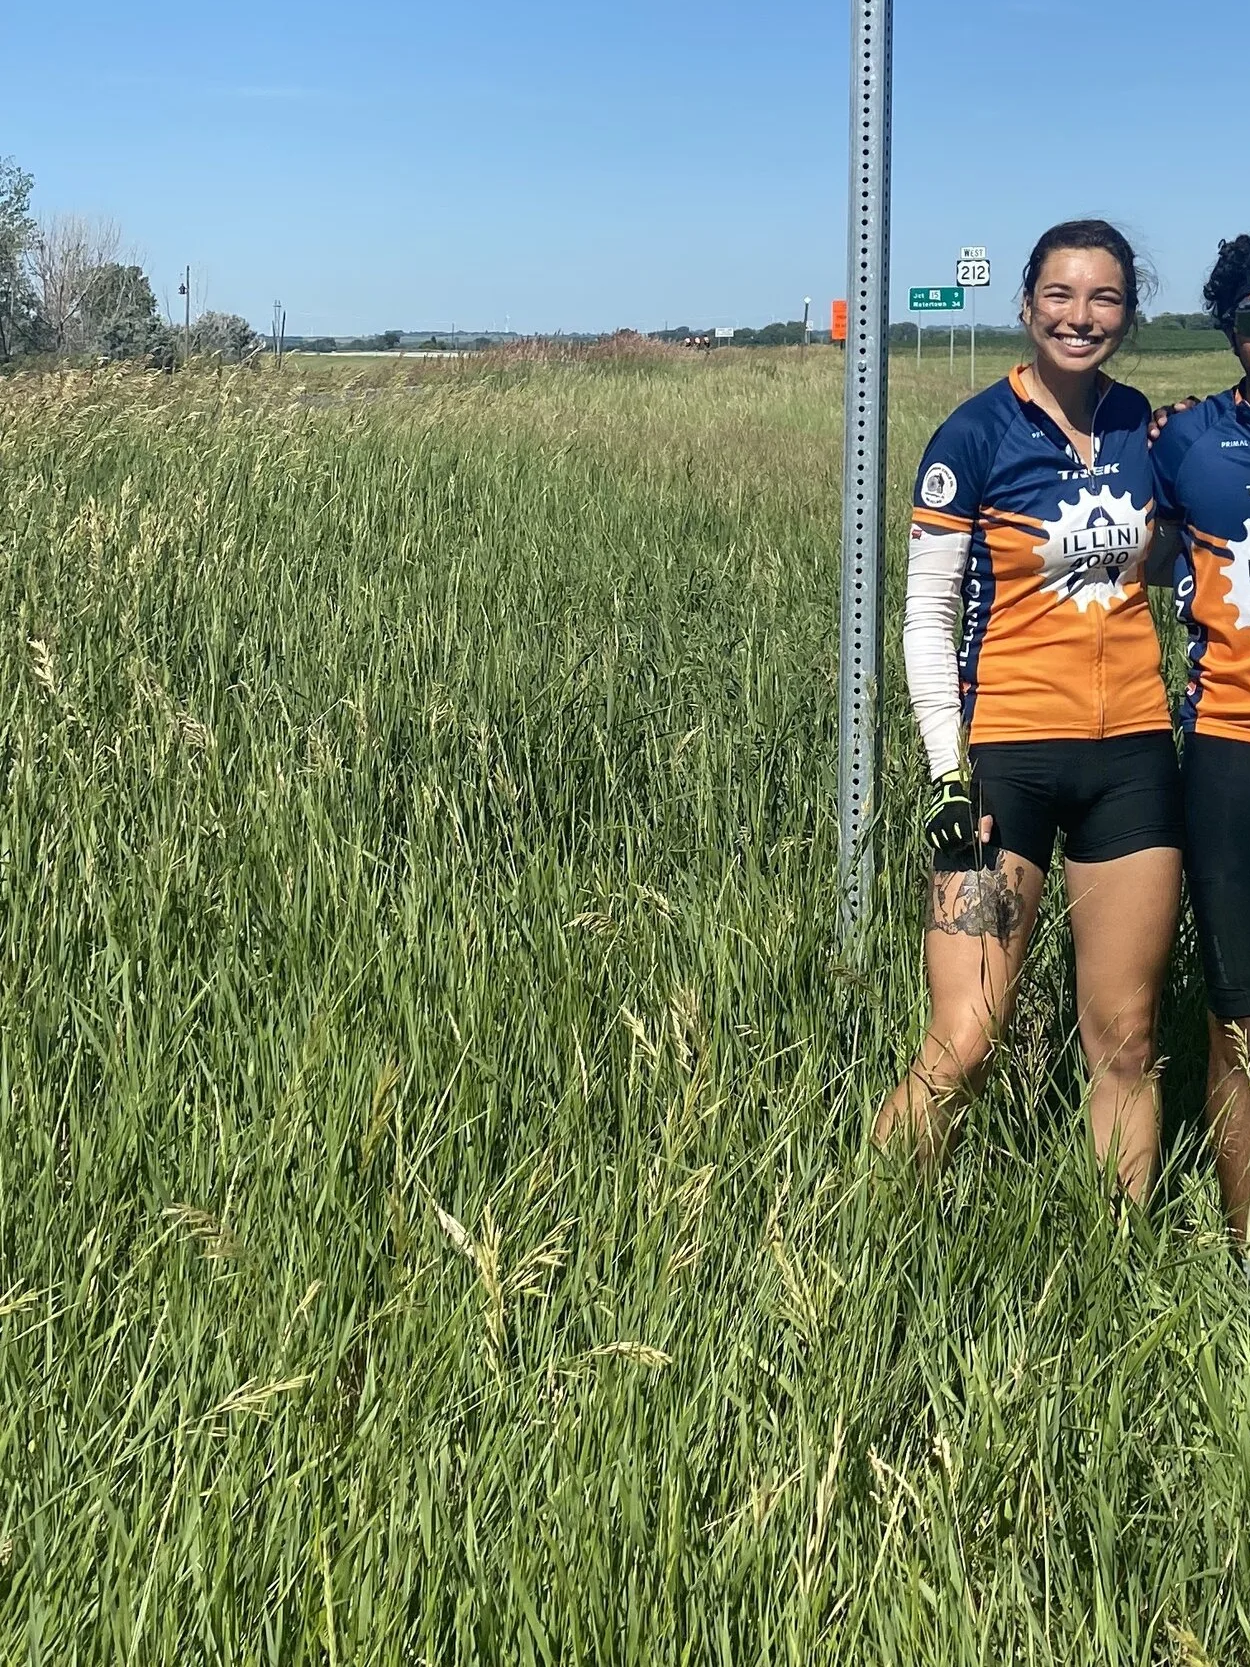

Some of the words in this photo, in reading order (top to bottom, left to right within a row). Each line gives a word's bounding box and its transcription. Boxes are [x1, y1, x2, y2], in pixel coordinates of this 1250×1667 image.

[963, 248, 984, 258] WEST
[961, 265, 986, 280] 212
[1221, 439, 1249, 448] PRIMAL
[1056, 462, 1120, 481] TREK
[1062, 526, 1139, 555] ILLINI
[1069, 551, 1129, 569] 4000
